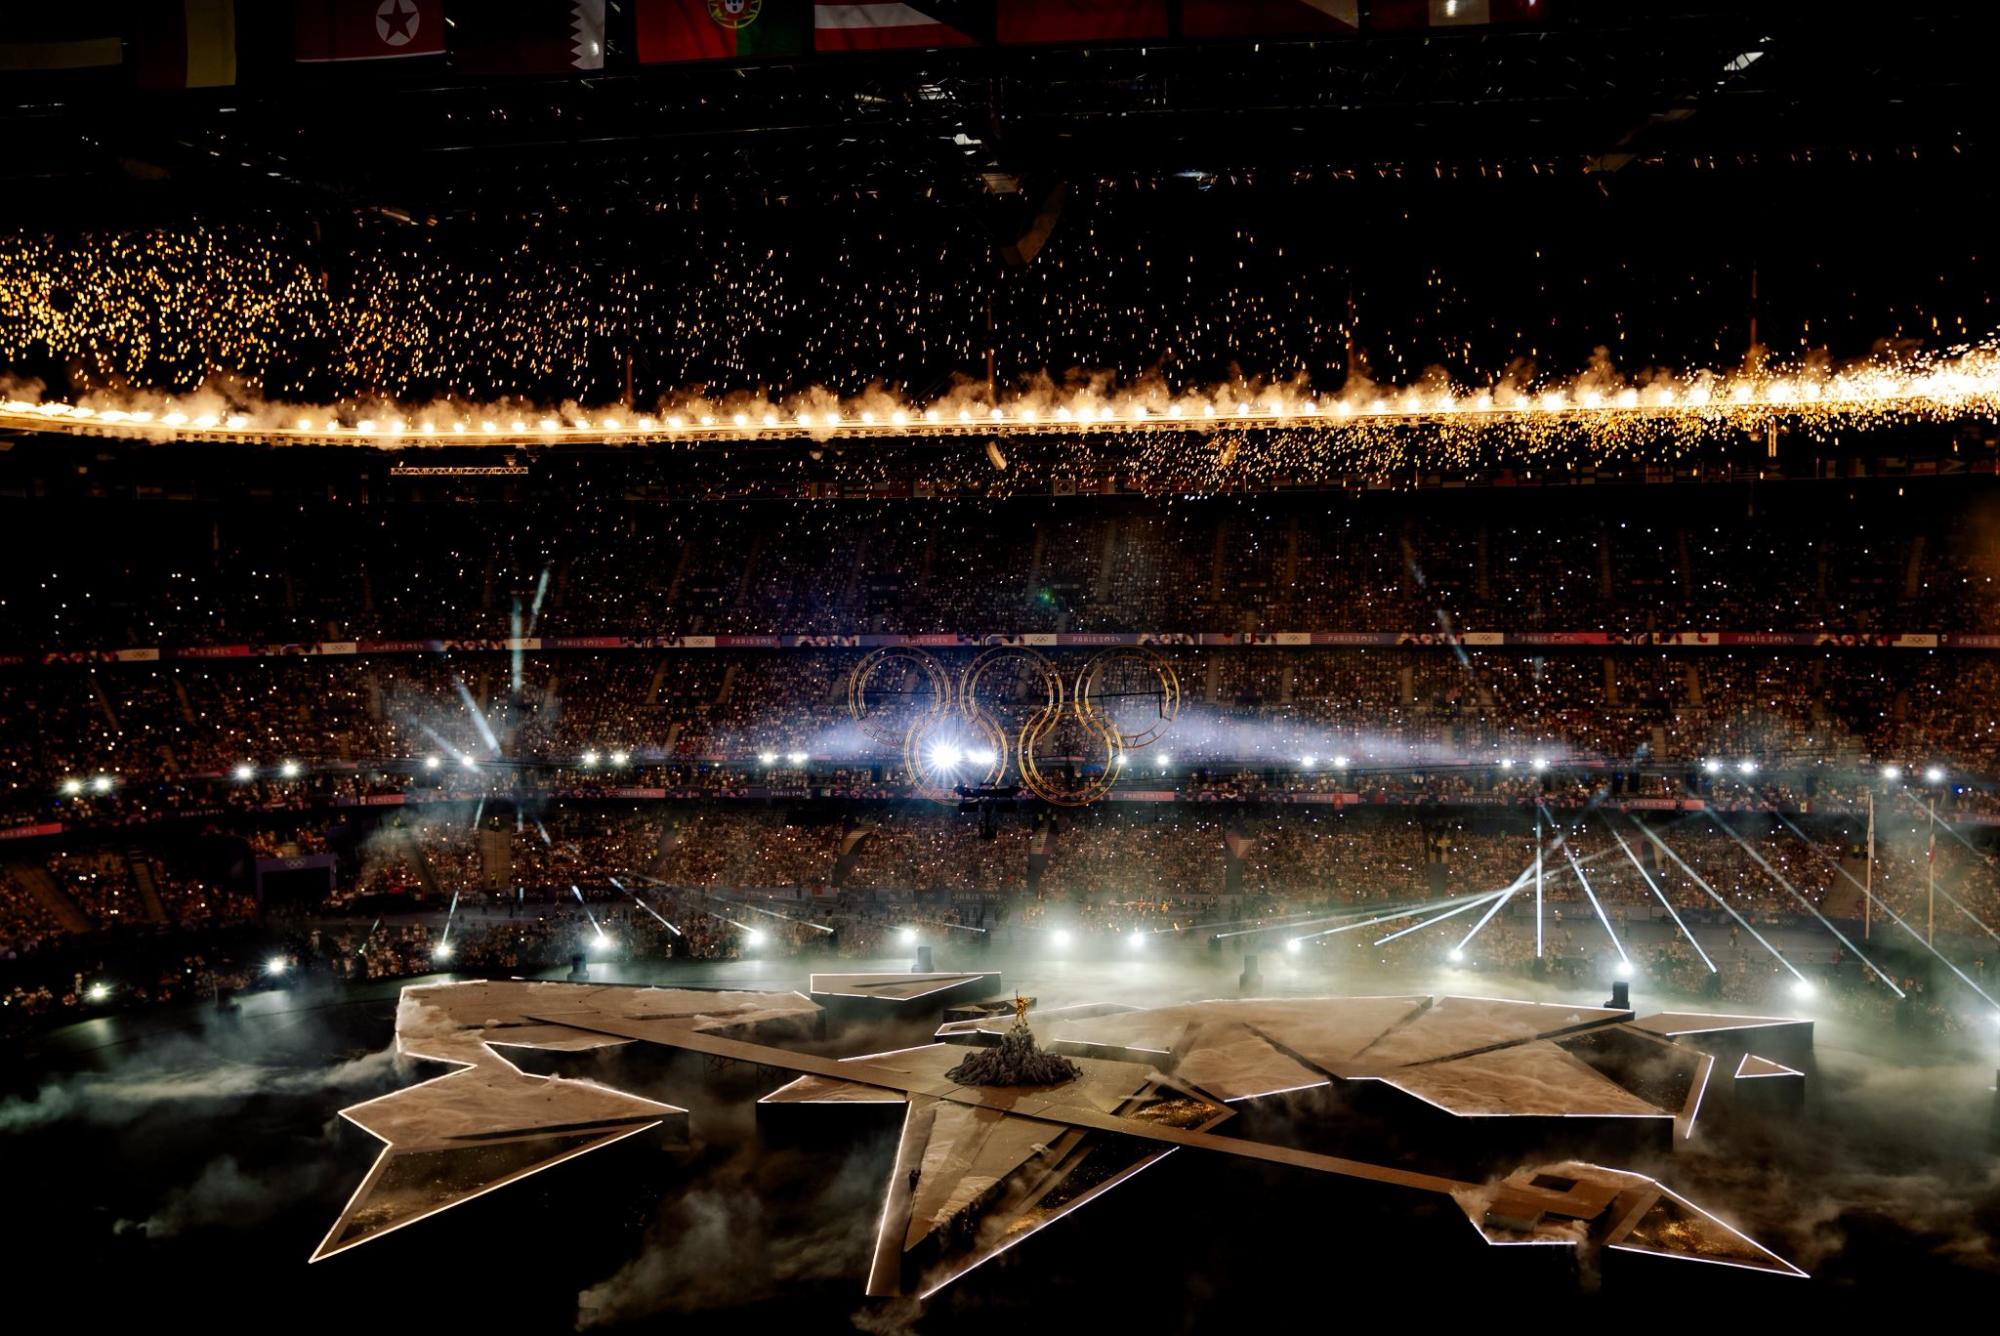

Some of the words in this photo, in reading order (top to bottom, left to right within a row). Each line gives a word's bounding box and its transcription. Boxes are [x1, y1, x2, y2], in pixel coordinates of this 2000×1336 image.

[583, 639, 605, 647] 2024
[1522, 635, 1548, 643] PARIS
[1737, 635, 1765, 643] PARIS
[1768, 635, 1794, 643] 2024
